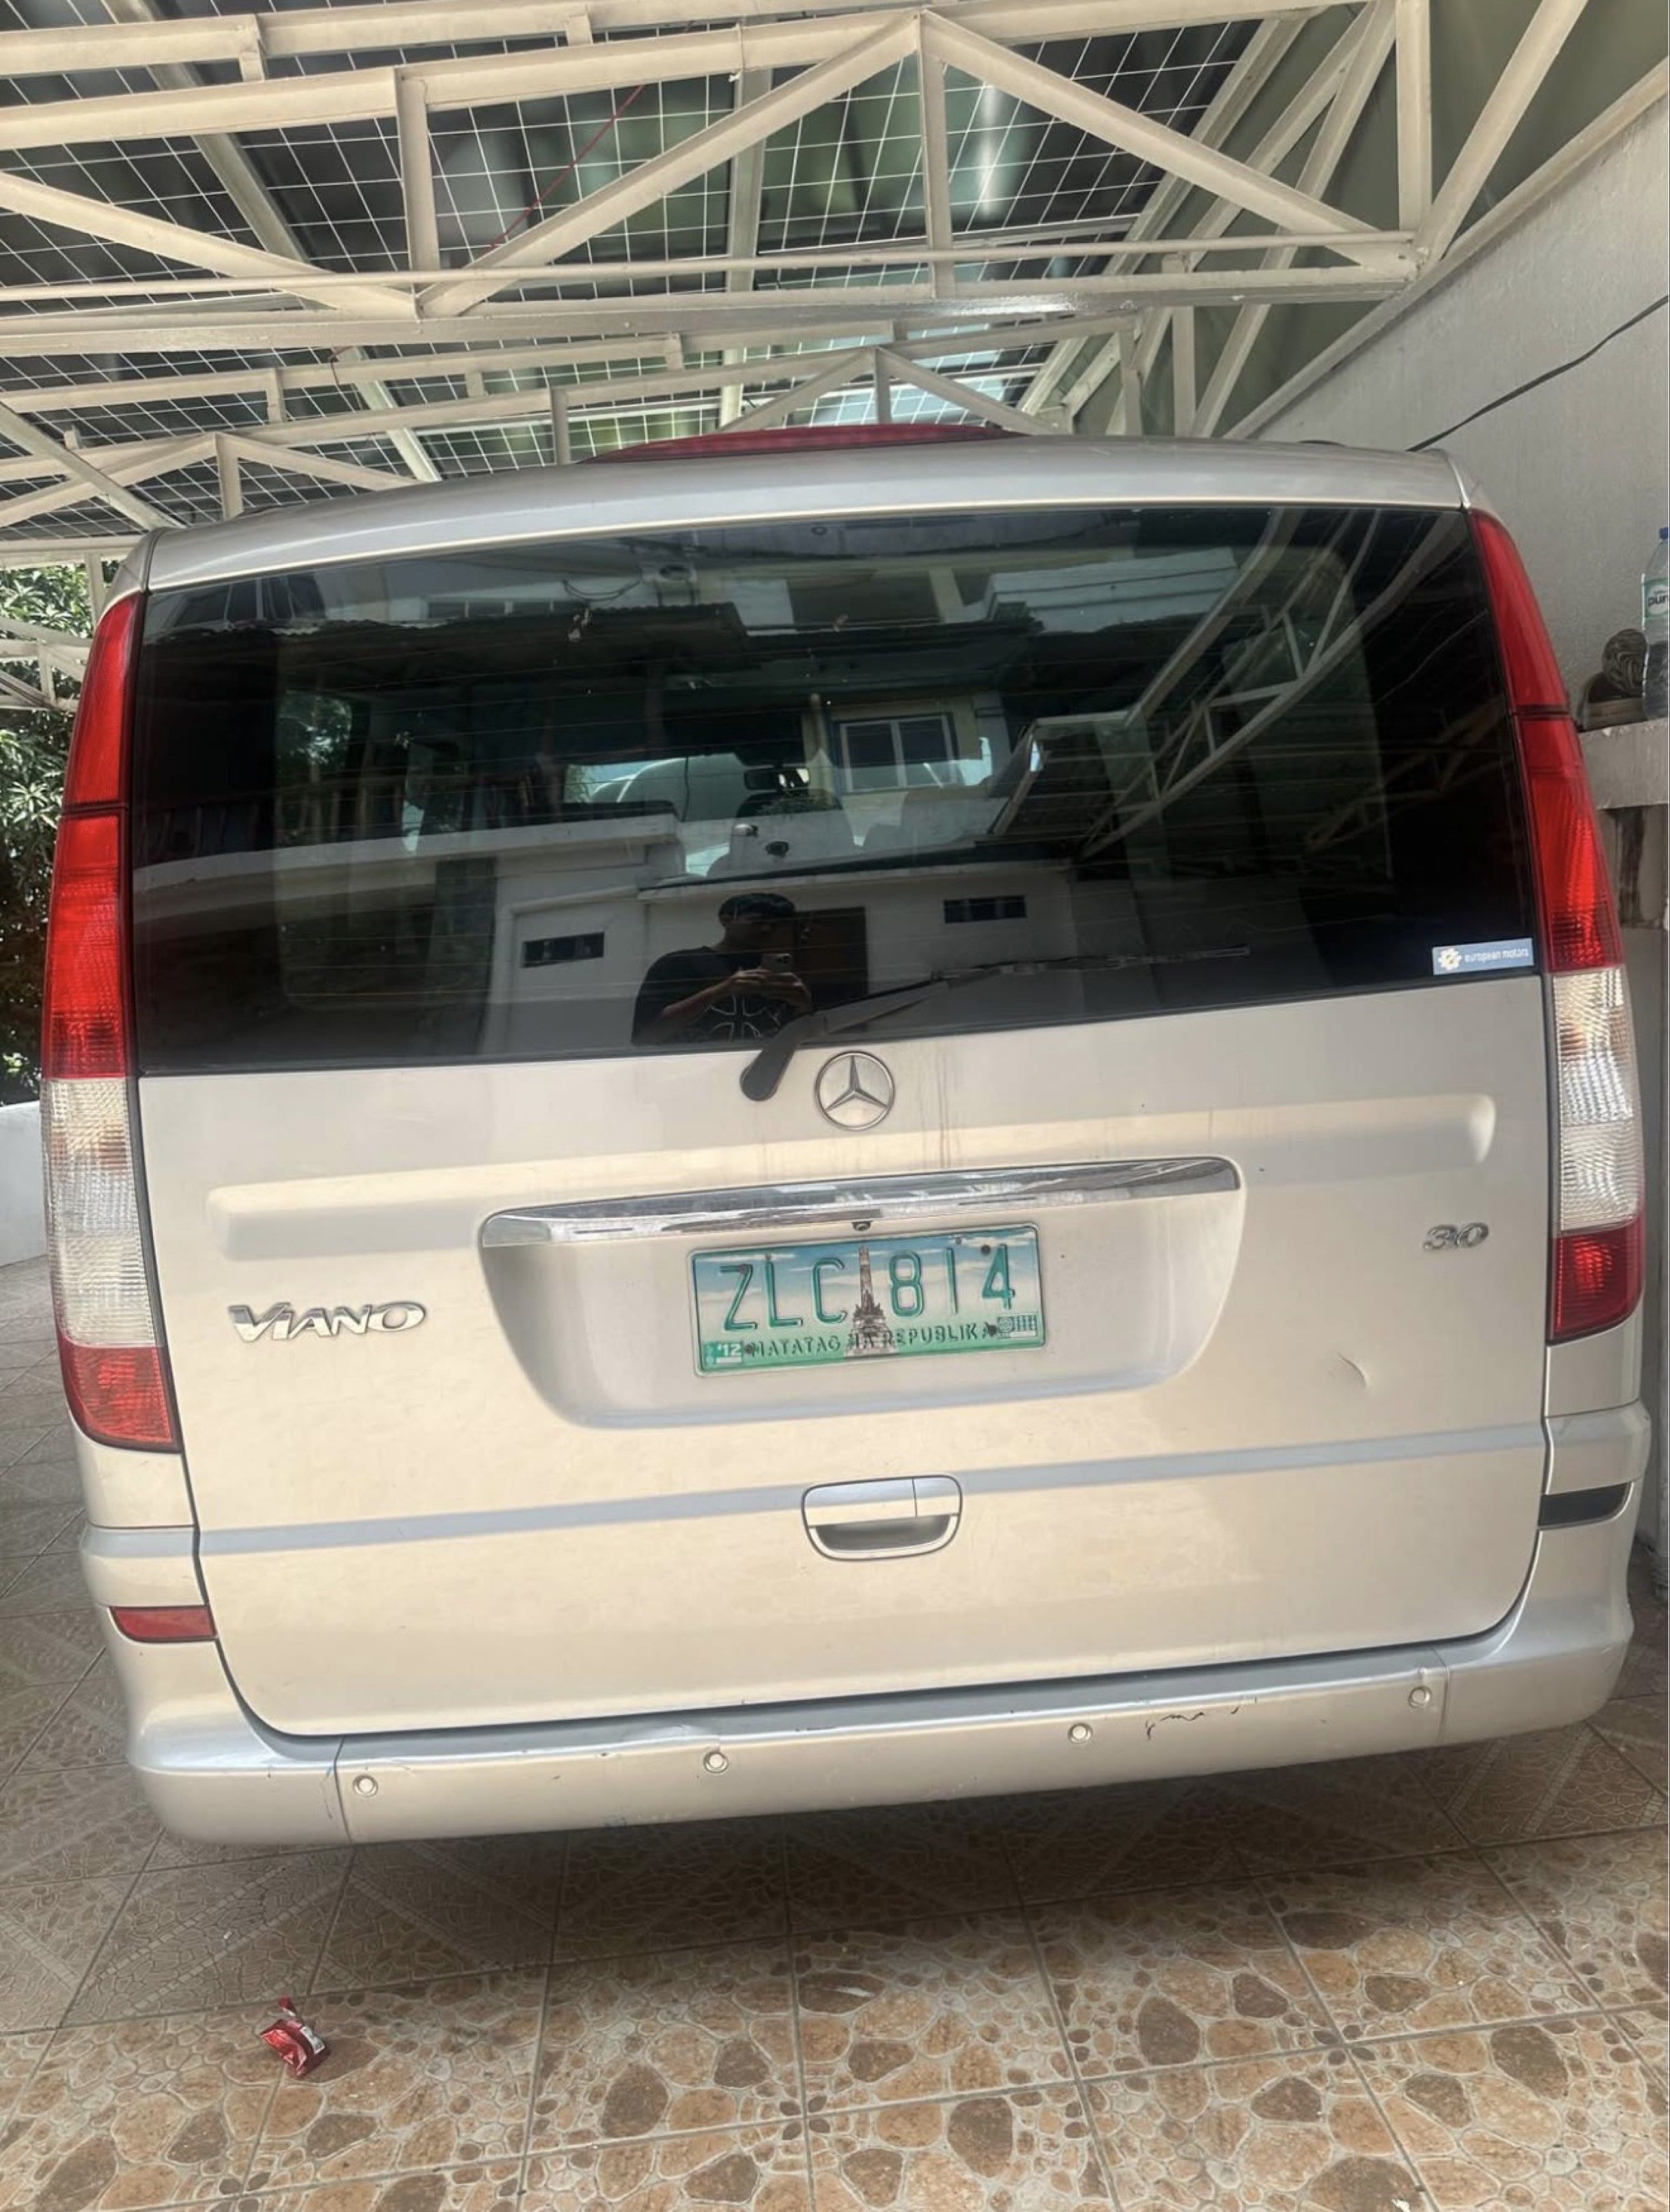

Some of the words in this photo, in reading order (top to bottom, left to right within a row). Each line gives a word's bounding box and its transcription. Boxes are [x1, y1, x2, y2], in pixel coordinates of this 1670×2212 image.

[720, 1257, 848, 1331] ZLC
[889, 1243, 1016, 1317] 814
[227, 1301, 427, 1342] VIANO
